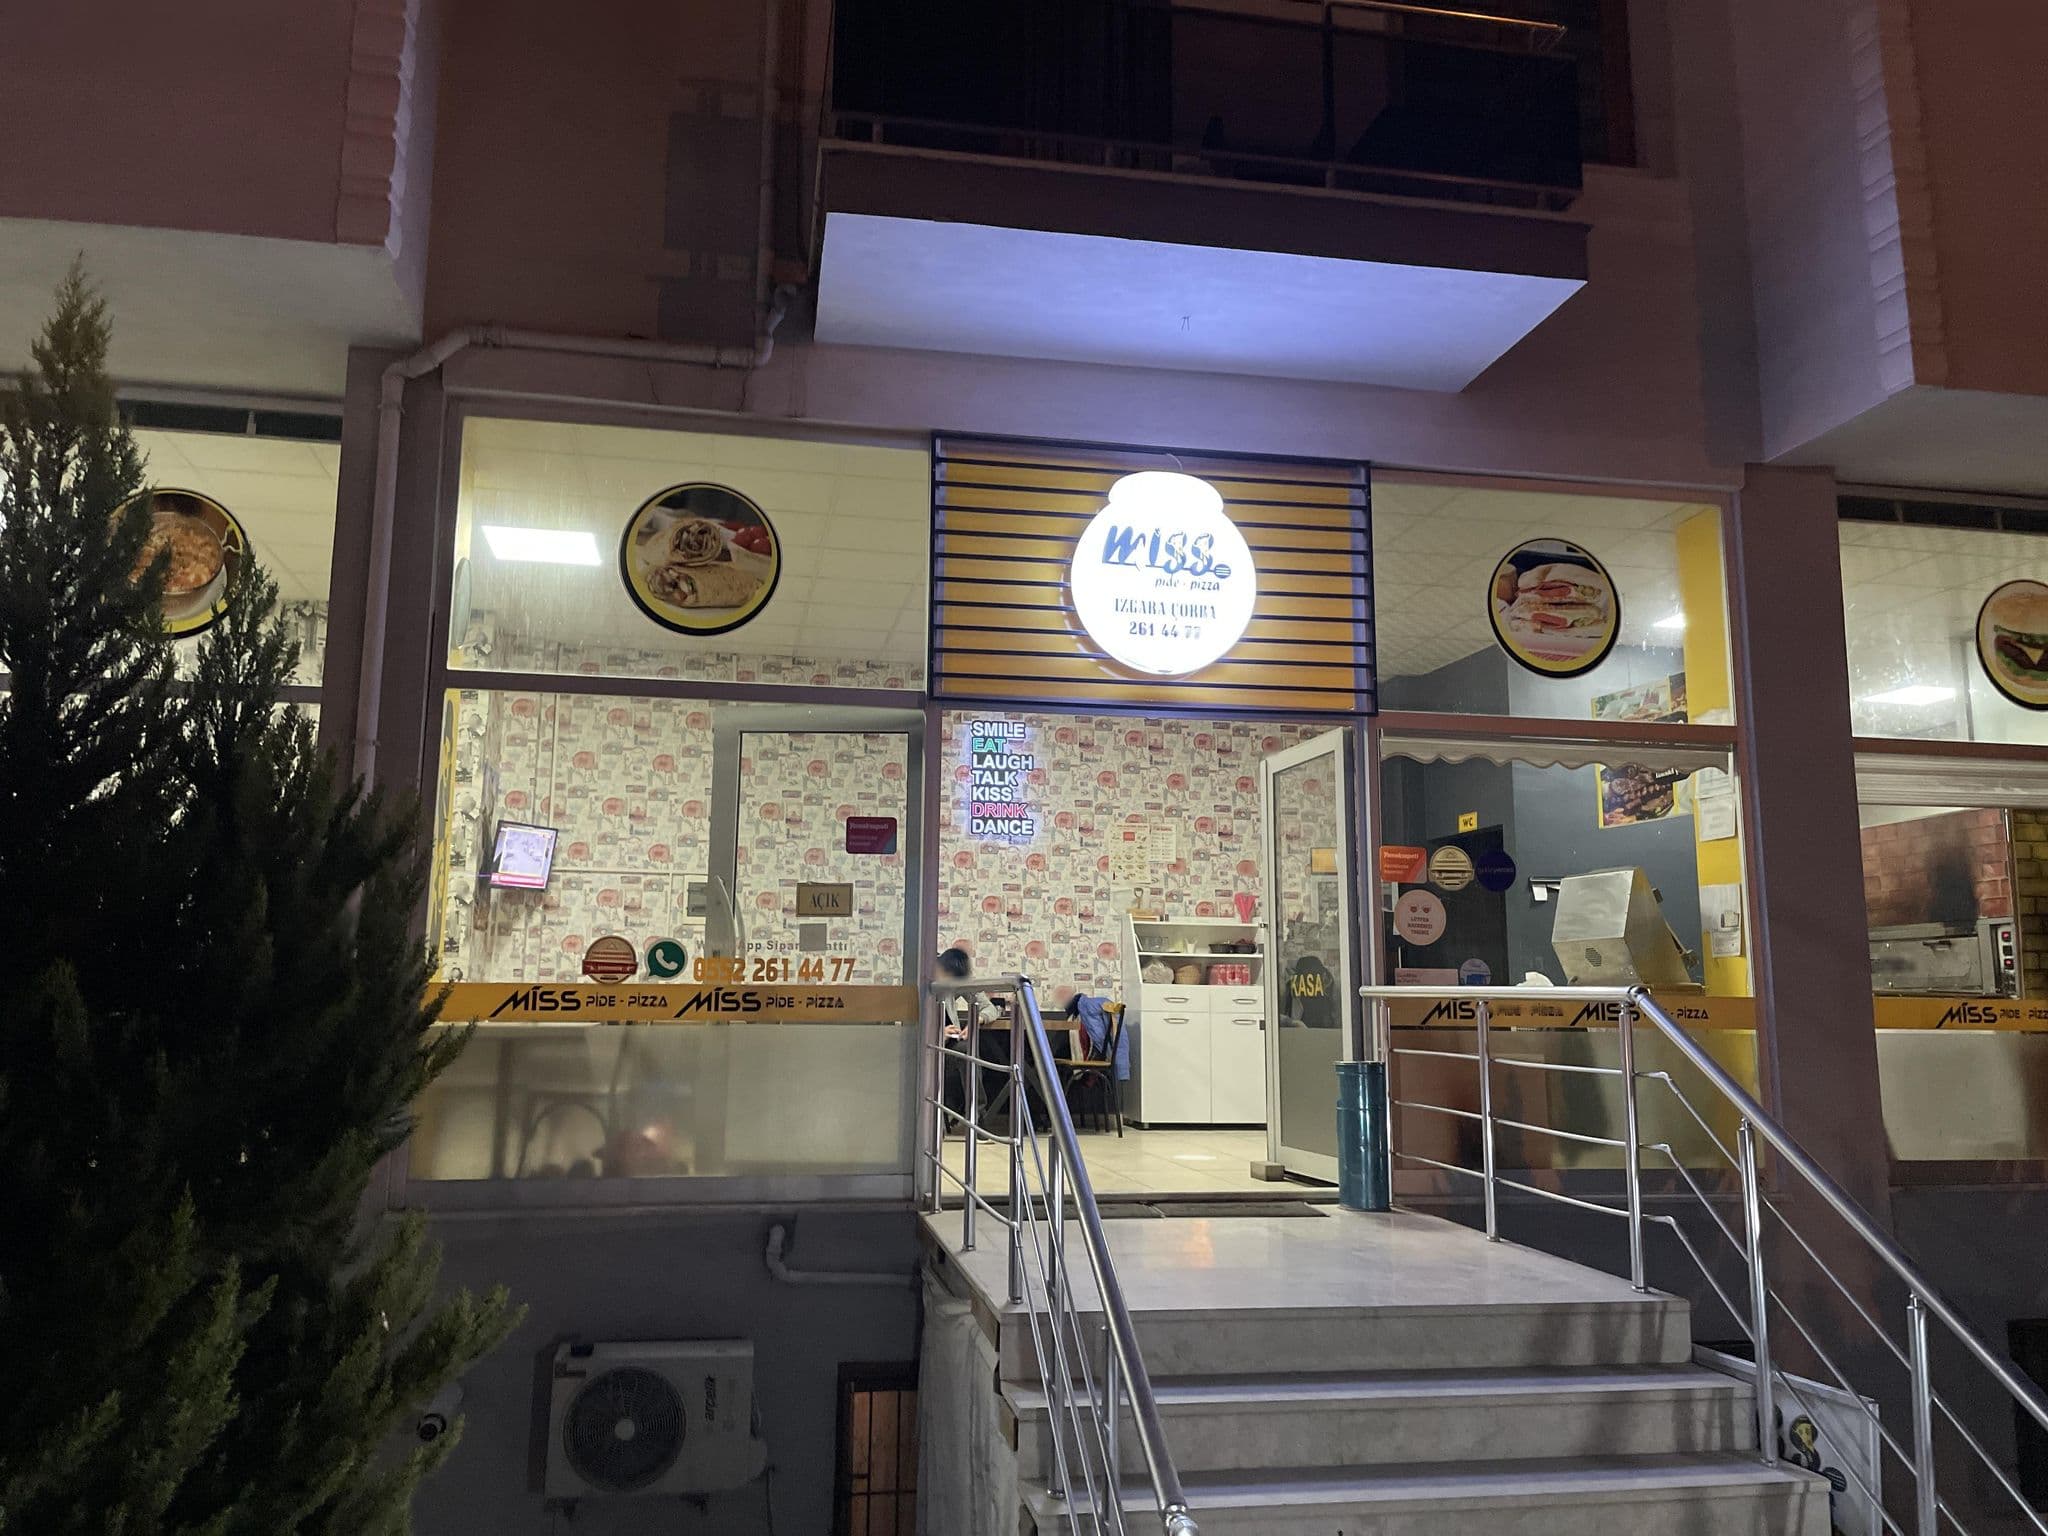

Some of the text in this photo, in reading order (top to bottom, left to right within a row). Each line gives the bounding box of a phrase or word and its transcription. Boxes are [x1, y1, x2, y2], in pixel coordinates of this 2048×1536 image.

[1190, 580, 1220, 591] pizza
[1114, 598, 1166, 615] IZGARA
[1129, 621, 1202, 639] 261 44 77
[972, 721, 1026, 738] SMILE
[972, 737, 1006, 753] EAT
[972, 754, 1034, 770] LAUGH
[972, 770, 1018, 786] TALK
[972, 786, 1012, 802] KISS
[972, 803, 1027, 818] DRINK
[972, 819, 1034, 835] DANCE
[1462, 817, 1473, 828] WC
[810, 892, 840, 910] AÇIK
[766, 940, 801, 952] Sipar
[693, 957, 856, 982] 0552 261 44 77
[1290, 973, 1324, 997] KASA
